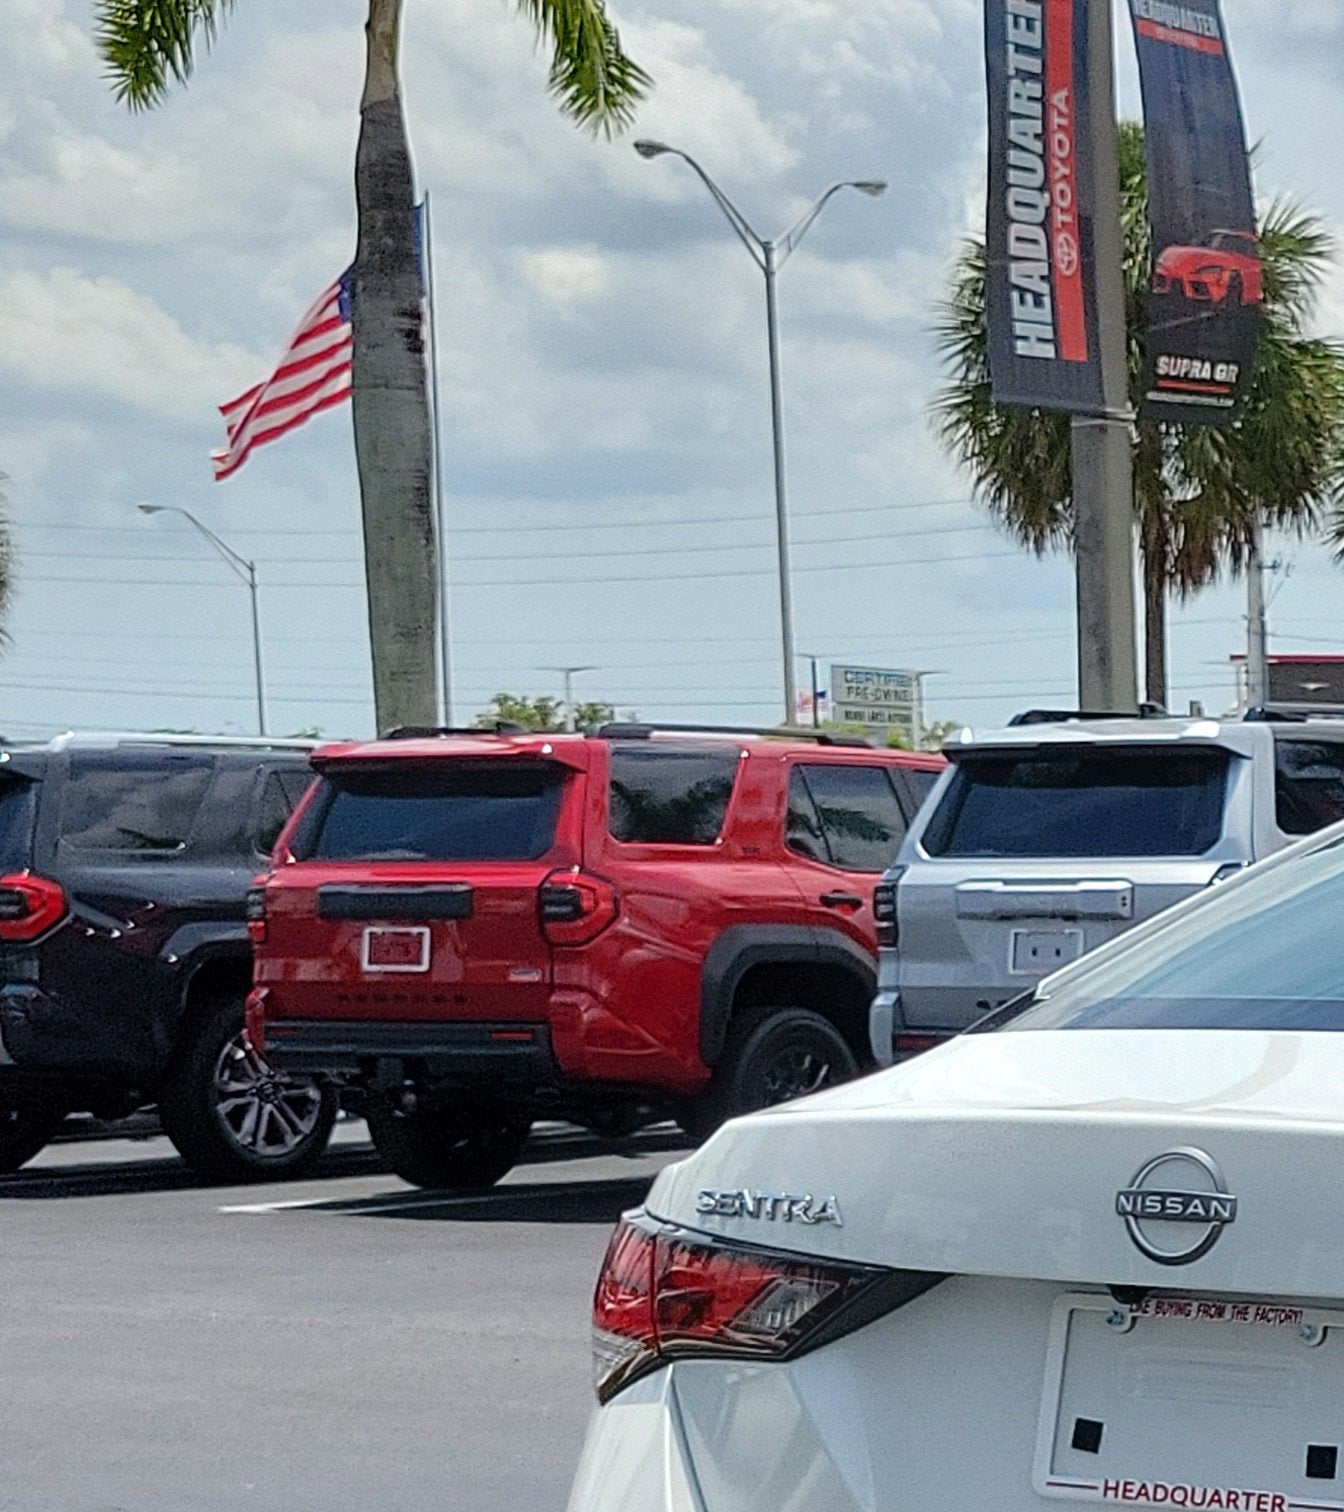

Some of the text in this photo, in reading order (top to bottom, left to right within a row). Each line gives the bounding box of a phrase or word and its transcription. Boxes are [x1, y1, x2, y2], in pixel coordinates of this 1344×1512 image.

[1050, 86, 1072, 228] TOYOTA
[1157, 356, 1239, 383] SUPRA GR
[697, 1189, 843, 1227] SENTRA
[1118, 1194, 1231, 1218] NISSAN
[1155, 1301, 1192, 1317] BUYING
[1198, 1303, 1225, 1319] FROM
[1231, 1305, 1250, 1321] THE
